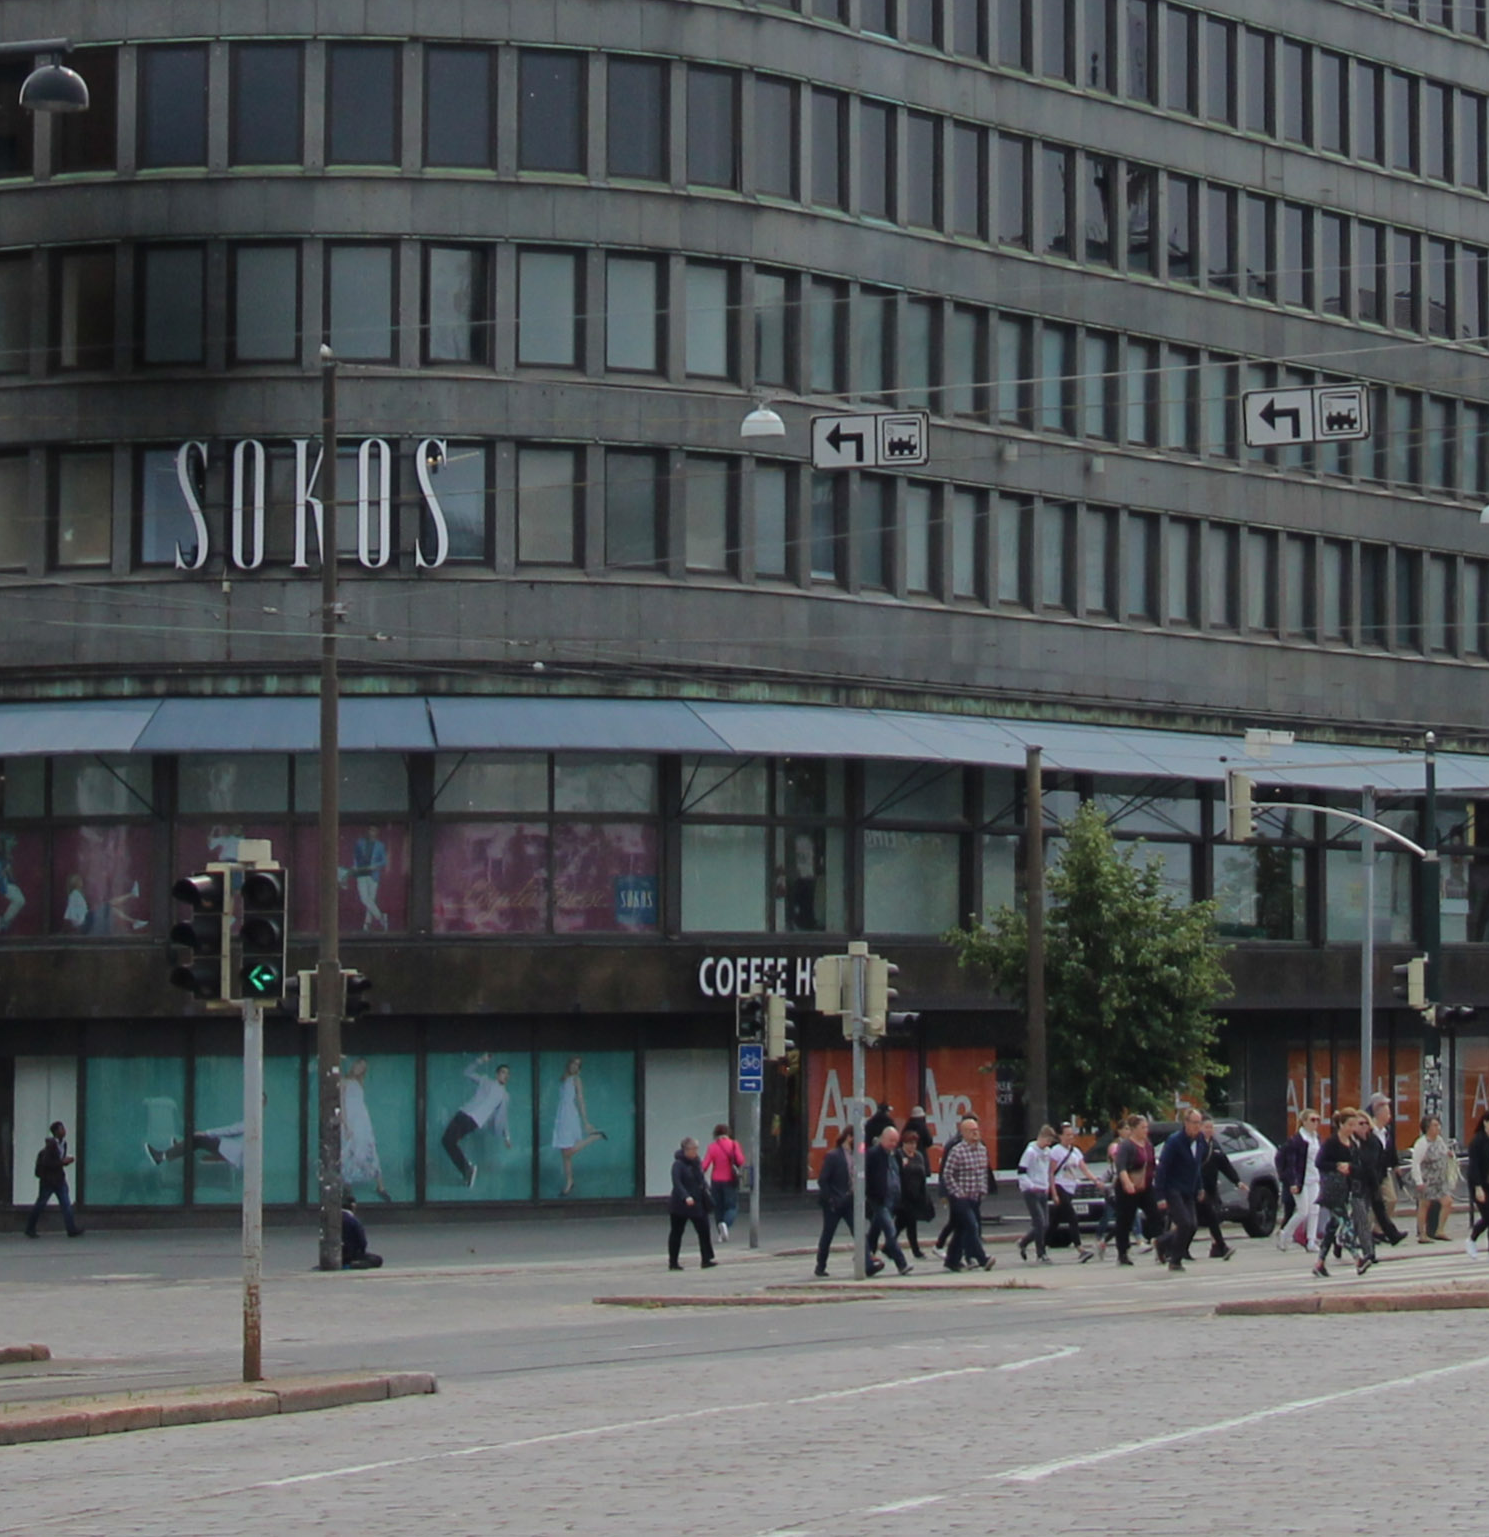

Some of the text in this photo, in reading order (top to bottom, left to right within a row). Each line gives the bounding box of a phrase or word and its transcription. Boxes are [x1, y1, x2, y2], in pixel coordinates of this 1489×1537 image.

[175, 438, 451, 571] SOKOS
[620, 889, 654, 909] SOKOS
[698, 957, 818, 997] COFFEE H
